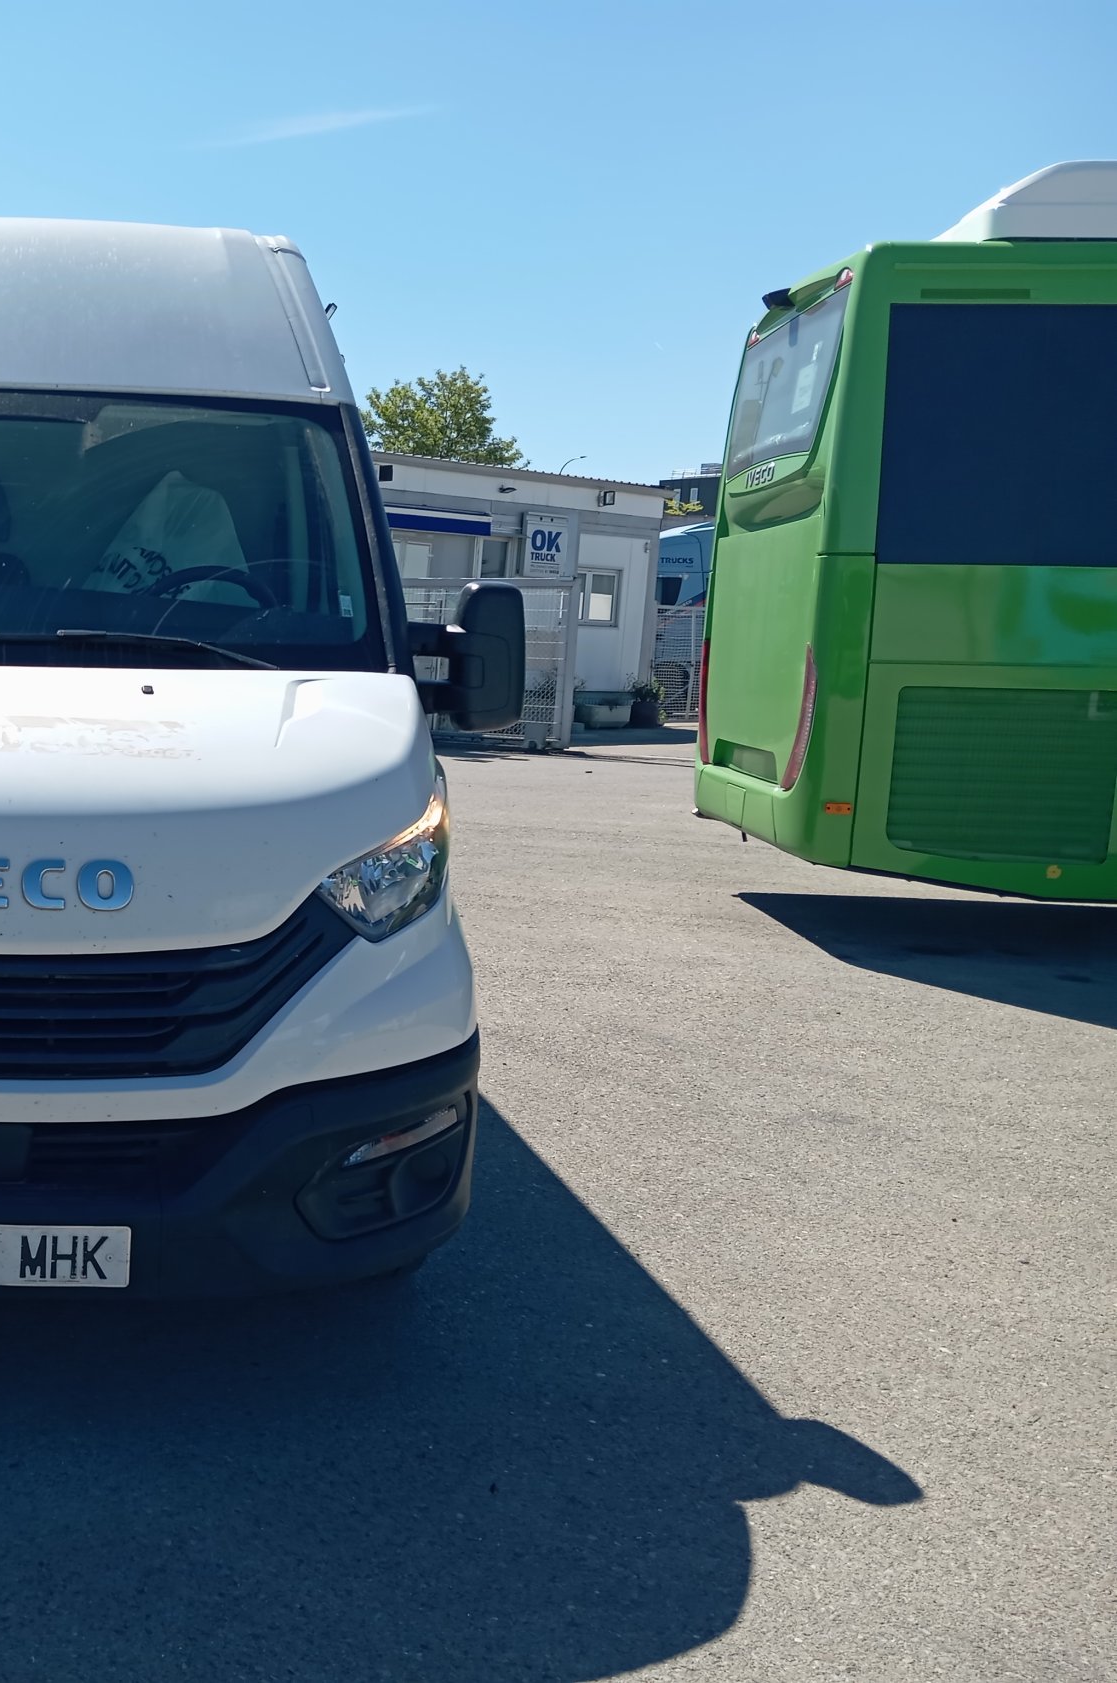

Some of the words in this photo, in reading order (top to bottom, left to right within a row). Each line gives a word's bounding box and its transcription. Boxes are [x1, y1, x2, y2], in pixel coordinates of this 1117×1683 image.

[745, 462, 775, 489] IVECO
[531, 529, 562, 553] OK
[530, 552, 556, 562] TRUCK
[660, 556, 694, 564] TRUCKS
[18, 1234, 109, 1280] MHK
